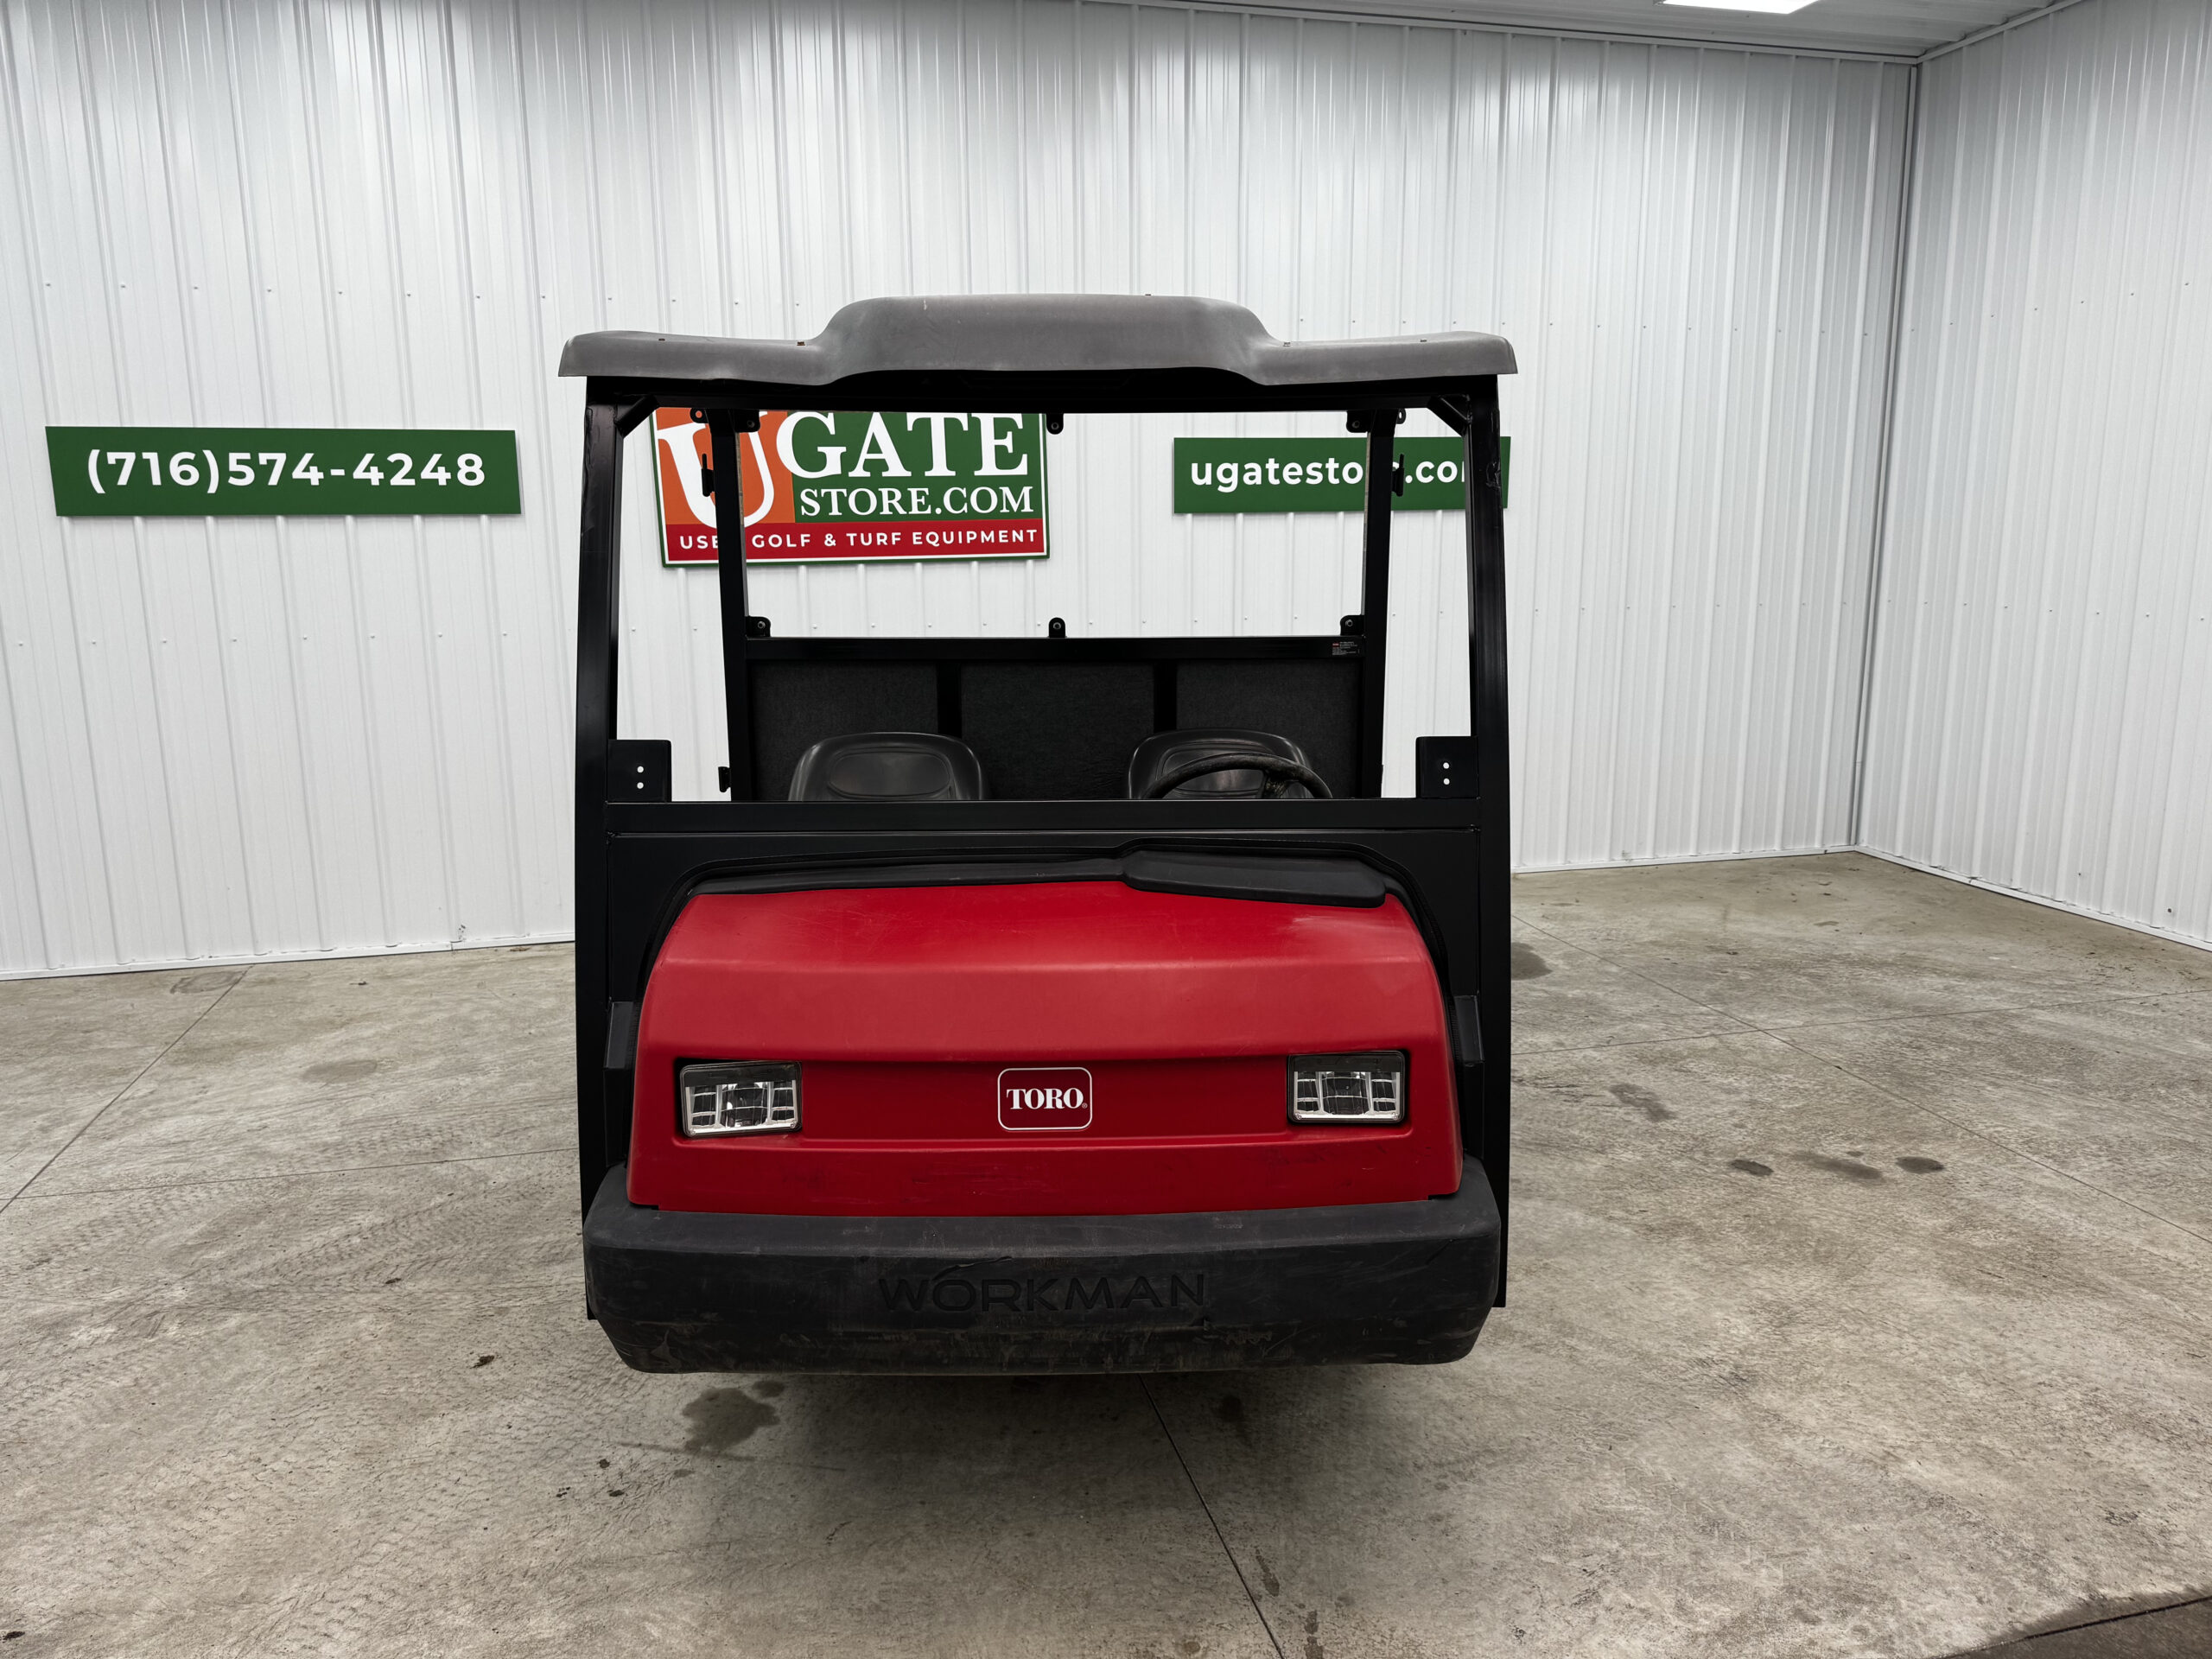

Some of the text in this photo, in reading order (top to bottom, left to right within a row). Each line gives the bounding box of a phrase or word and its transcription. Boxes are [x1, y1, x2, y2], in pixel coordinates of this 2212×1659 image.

[87, 448, 486, 494] (716)574-4248
[1191, 457, 1465, 493] ugatesto.co
[800, 486, 1034, 517] STORE.COM
[679, 530, 1038, 550] USE GOLF & TURF EQUIPMENT
[1006, 1087, 1084, 1109] TORO
[878, 1273, 1206, 1313] WORKMAN
